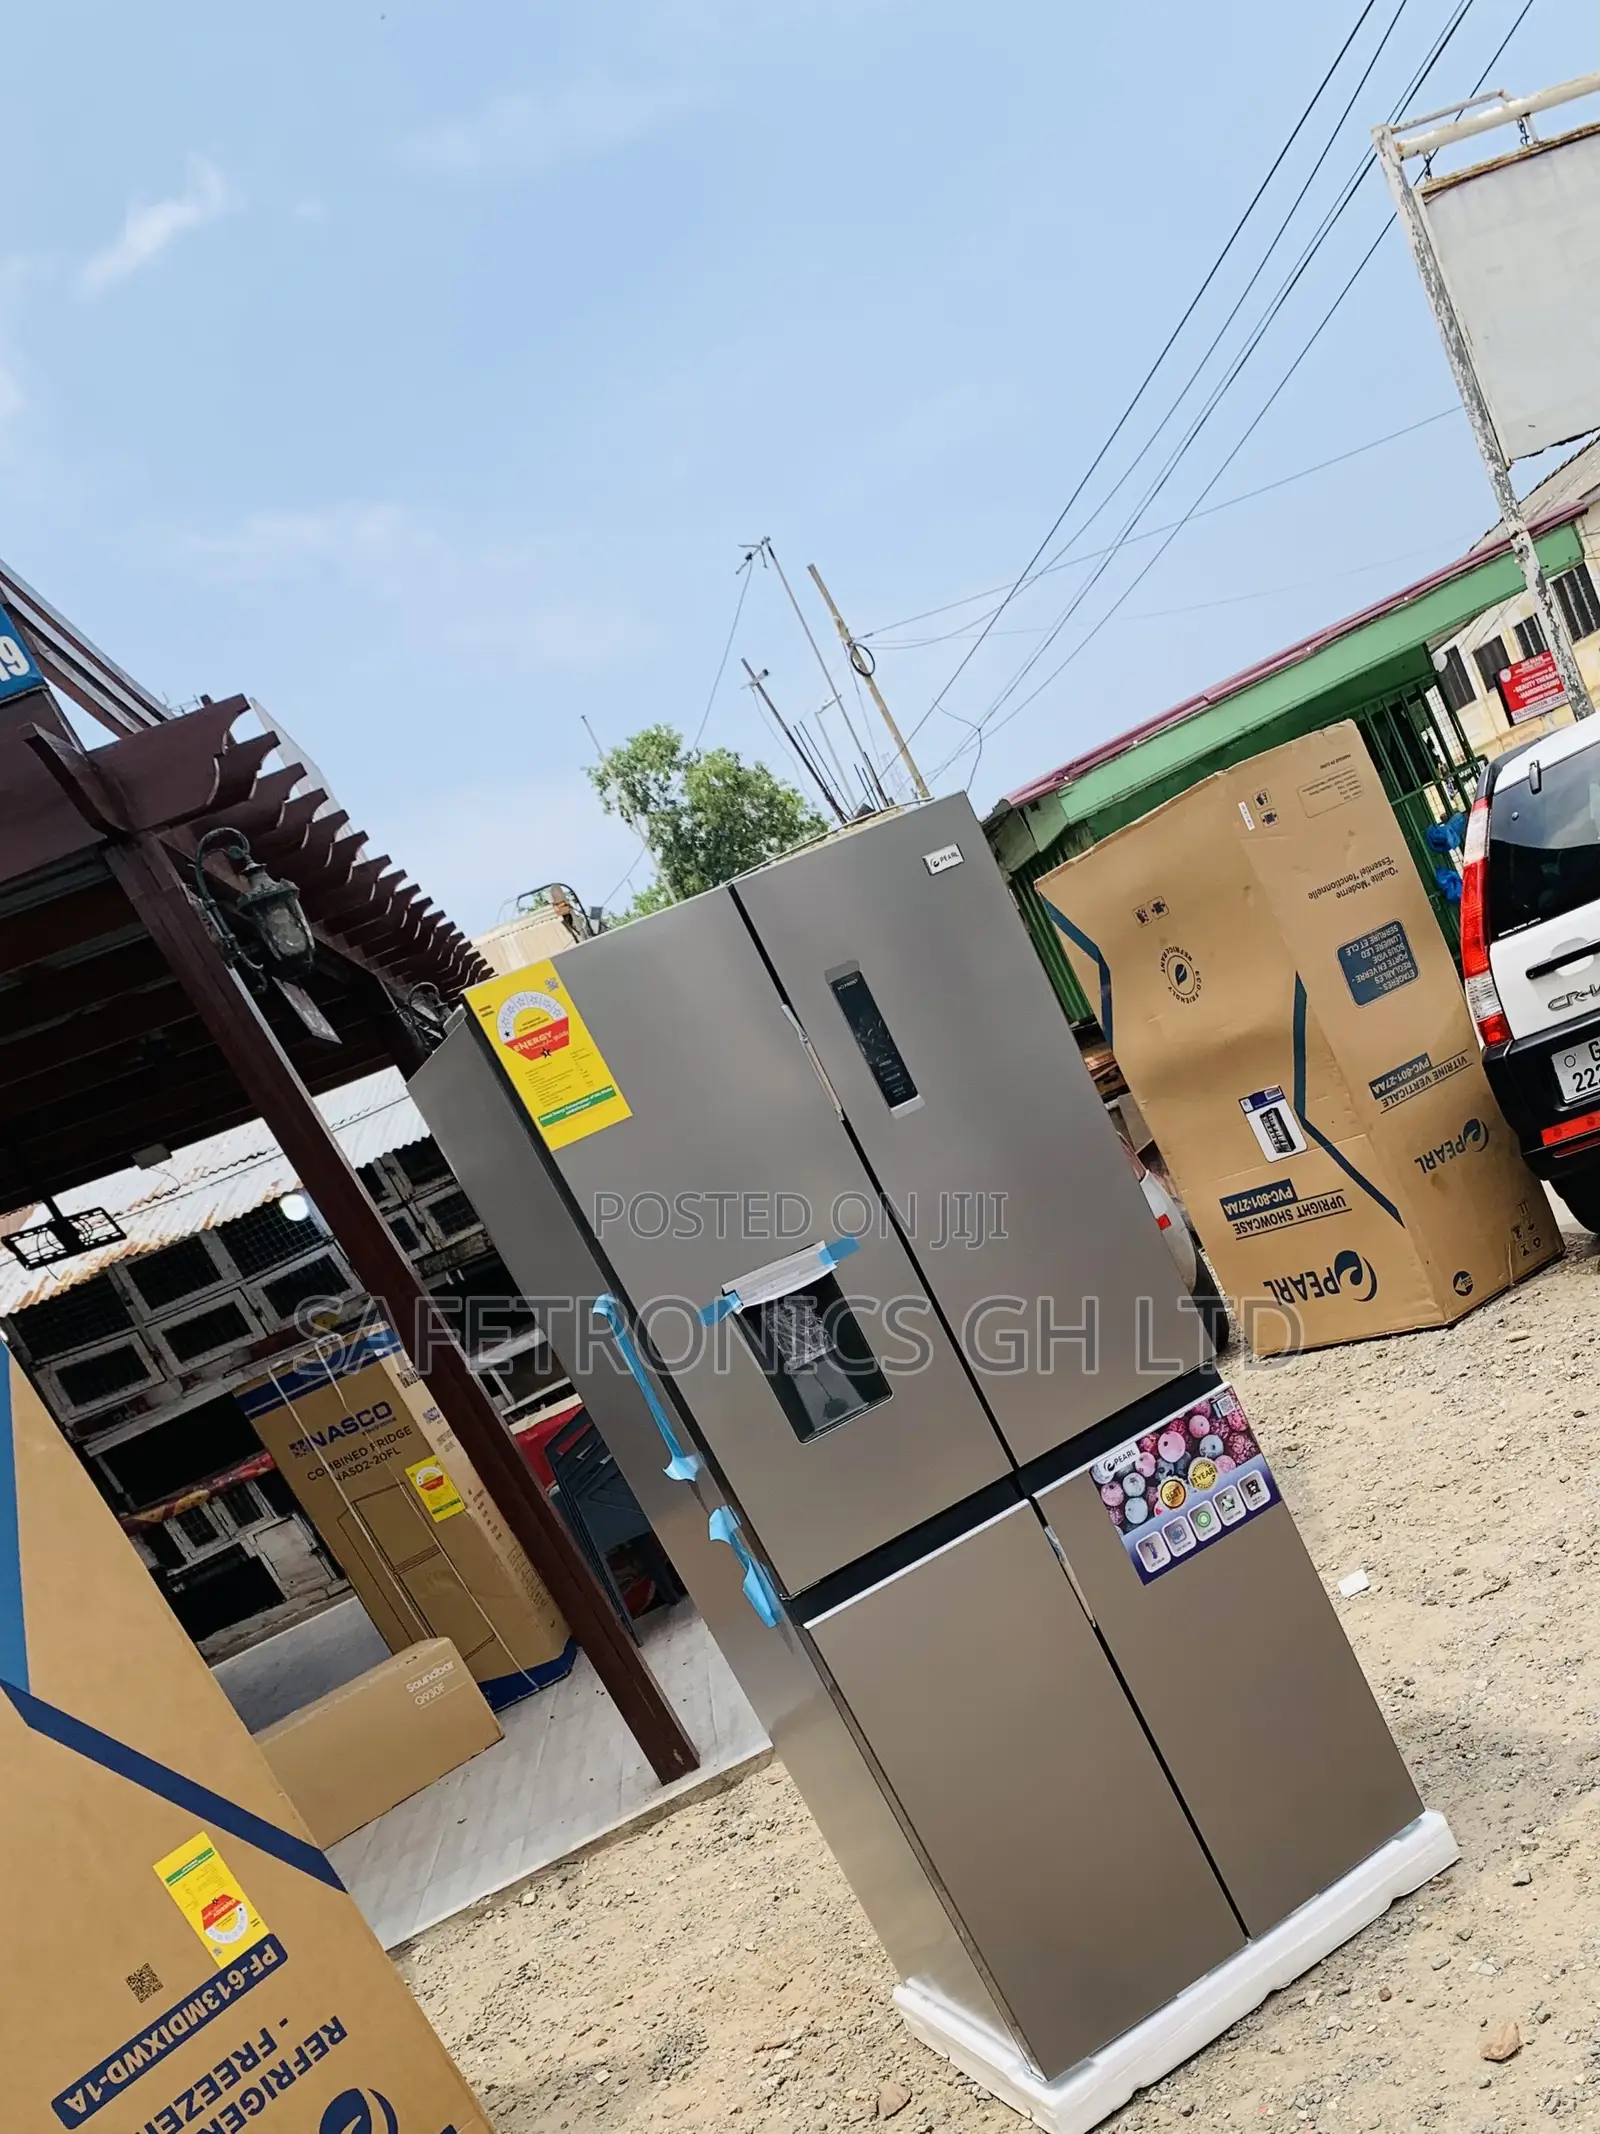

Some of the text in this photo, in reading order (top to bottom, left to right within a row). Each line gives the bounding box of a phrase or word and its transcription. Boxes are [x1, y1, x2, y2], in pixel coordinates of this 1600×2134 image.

[940, 851, 960, 862] PEARL
[1368, 924, 1399, 943] SERRURE
[1361, 948, 1372, 959] LED
[1372, 942, 1405, 964] SOUS VIDE
[1386, 953, 1408, 970] PORTE
[1355, 966, 1378, 983] VERRE
[513, 1031, 552, 1051] ENERGY
[1372, 1058, 1430, 1094] PVC-801-27AA
[1381, 1055, 1468, 1108] VITRINE VERTICALE
[1414, 1134, 1467, 1174] PEARL
[1224, 1186, 1294, 1216] PVC-801-27AA
[1232, 1195, 1347, 1235] UPRIGHT SHOWCASE
[1263, 1266, 1341, 1306] PEARL
[306, 1401, 393, 1451] NASCO
[307, 1447, 368, 1481] COMBINED
[369, 1425, 413, 1452] FRIDGE
[1114, 1448, 1136, 1465] PEARL
[1197, 1467, 1215, 1481] YEAR
[1165, 1486, 1182, 1502] BEST
[406, 1660, 454, 1693] Soundbar
[415, 1682, 445, 1705] Q930F
[63, 1943, 279, 2115] PF-613MDIXWD-1A
